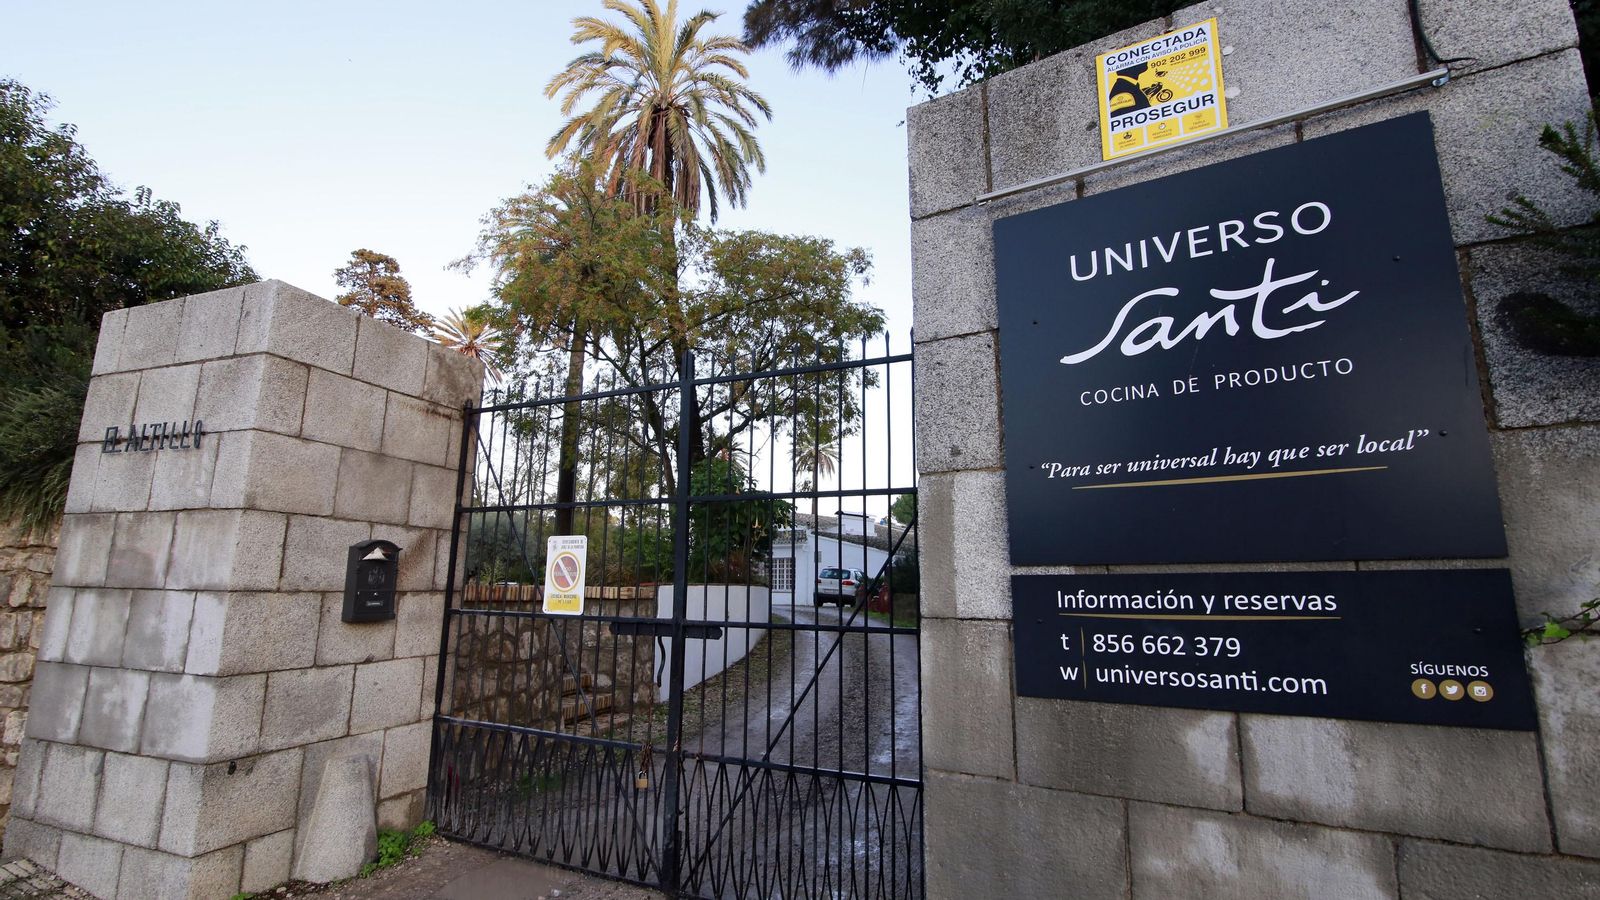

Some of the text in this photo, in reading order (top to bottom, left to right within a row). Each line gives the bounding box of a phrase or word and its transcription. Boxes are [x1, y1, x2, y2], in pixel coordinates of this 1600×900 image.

[1106, 27, 1207, 66] CONECTADA
[1107, 61, 1135, 73] ALARMA
[1135, 54, 1151, 64] CON
[1151, 48, 1172, 60] AVISO
[1150, 59, 1167, 68] 902
[1169, 53, 1187, 63] 202
[1188, 46, 1206, 57] 999
[1110, 93, 1215, 132] PROSEGUR
[1070, 201, 1332, 281] UNIVERSO
[1060, 258, 1360, 365] Santi
[1081, 358, 1352, 405] COCINA DE PRODUCTO
[125, 420, 202, 452] ALTILLO
[1041, 429, 1429, 478] “Para ser universal hay que ser local”
[1058, 589, 1336, 614] Información y reservas
[1061, 634, 1240, 657] t 856 662 379
[1060, 665, 1326, 694] w universosanti.com
[1411, 661, 1488, 676] SÍGUENOS
